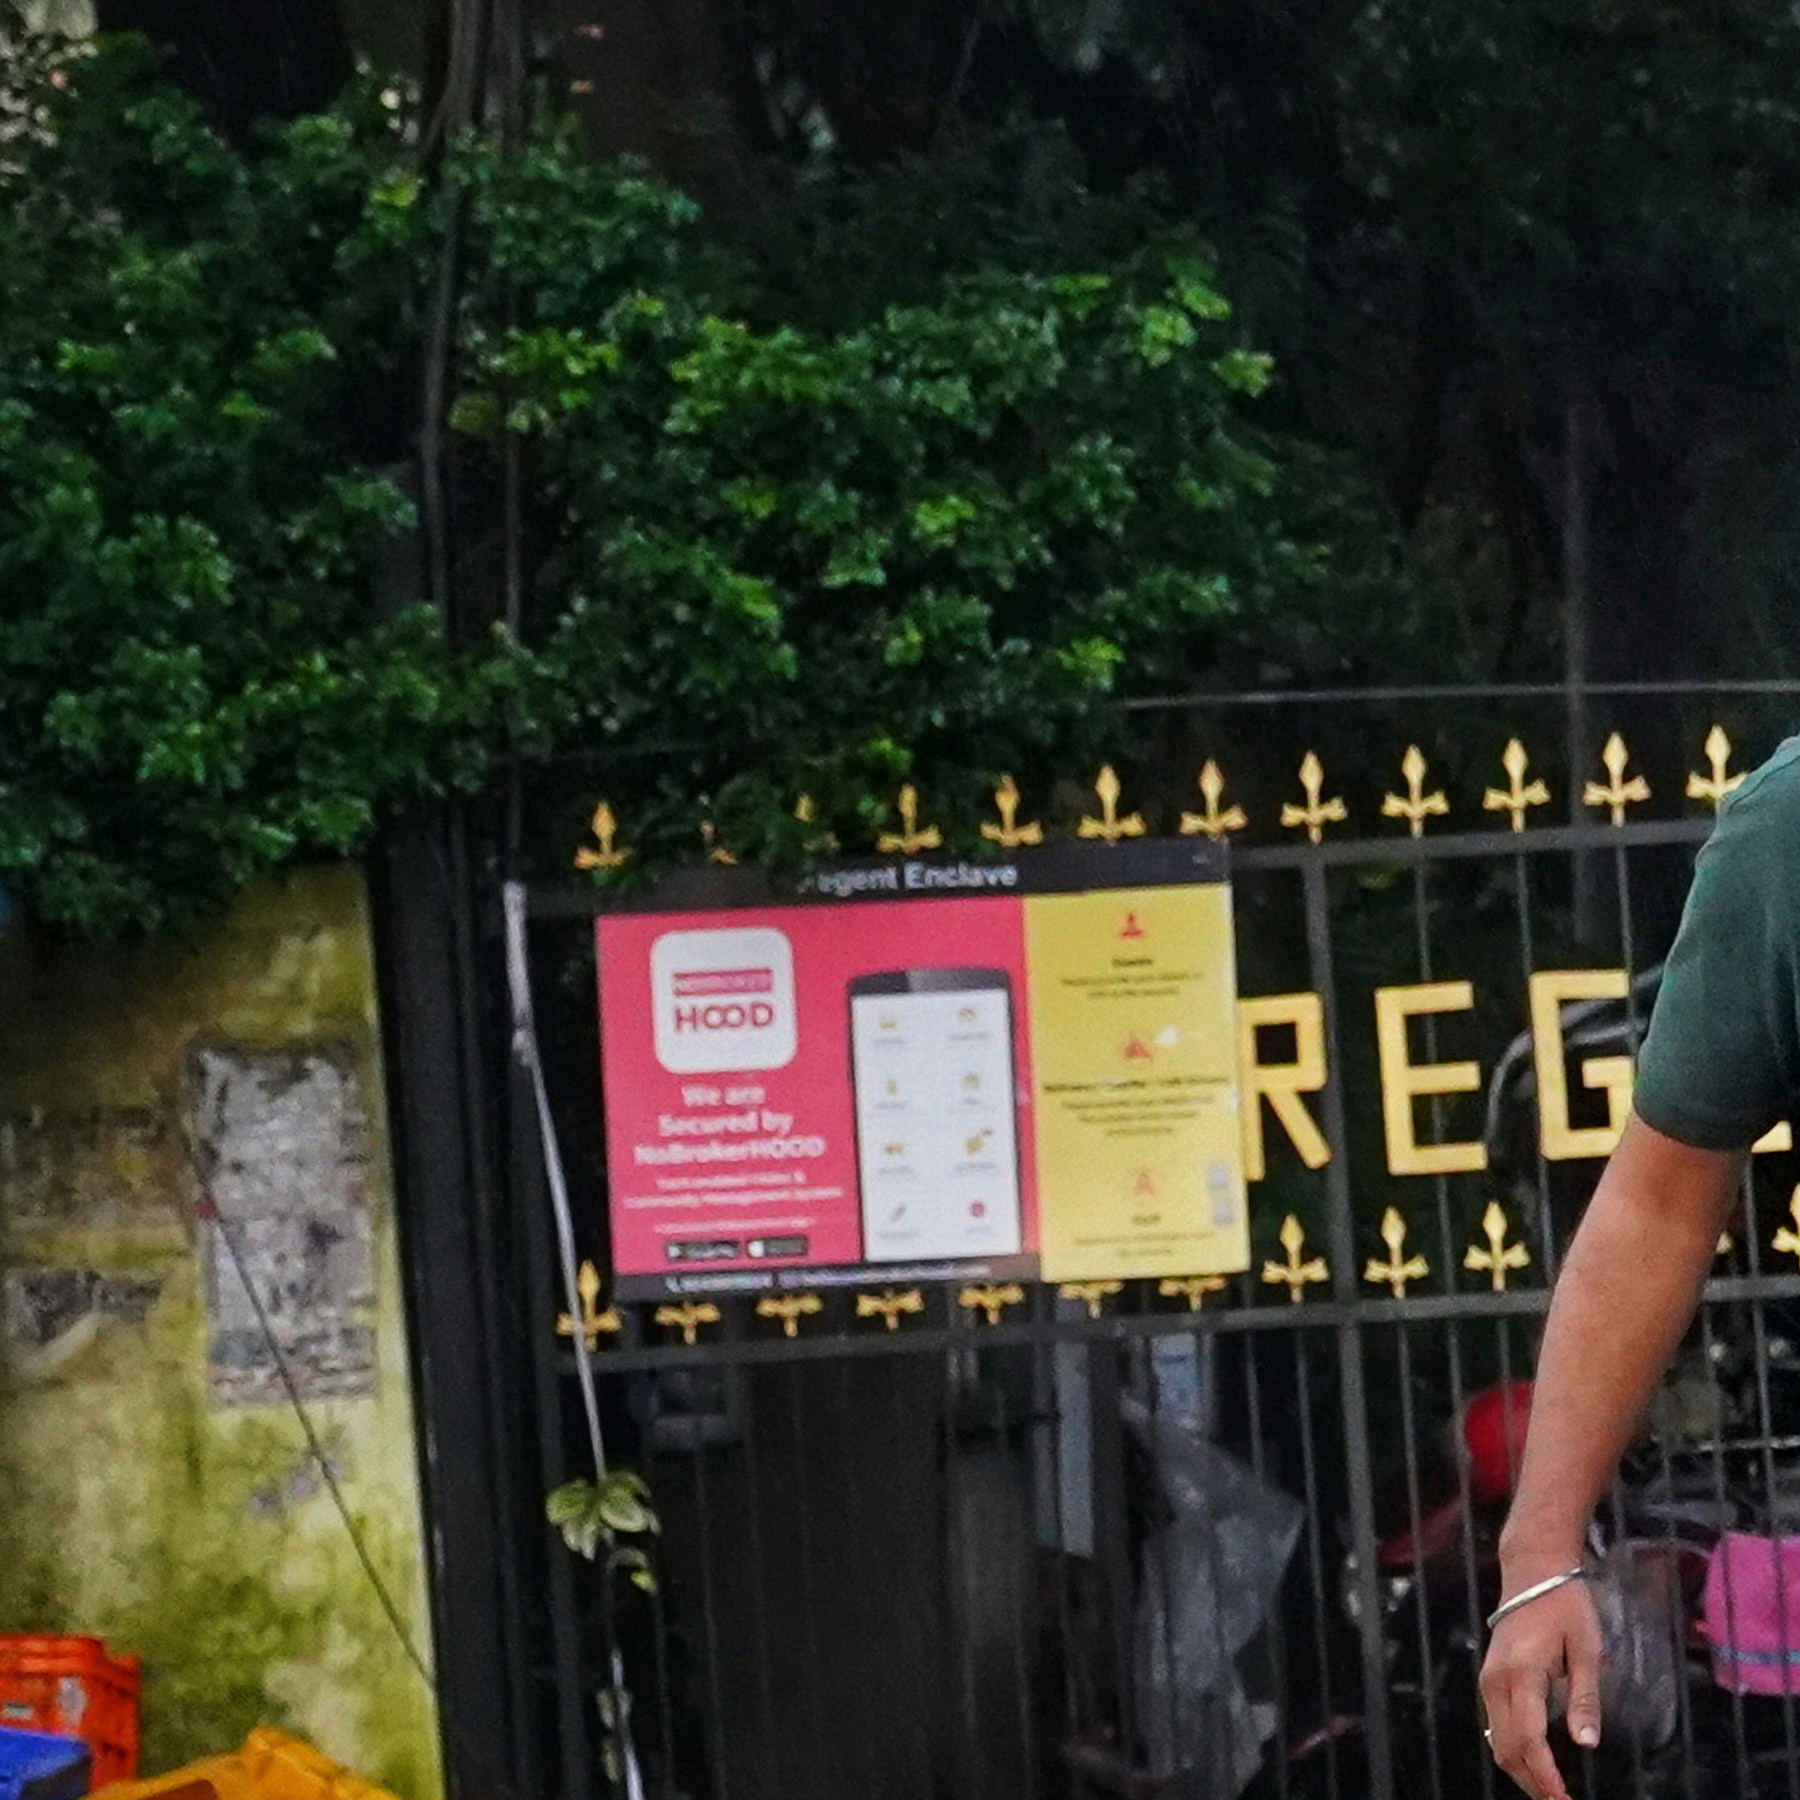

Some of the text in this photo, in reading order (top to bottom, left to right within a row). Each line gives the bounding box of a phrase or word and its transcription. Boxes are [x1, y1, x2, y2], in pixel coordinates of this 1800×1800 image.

[904, 861, 1018, 890] Enclave
[674, 1002, 774, 1033] HOOD
[657, 1108, 795, 1137] Secured by
